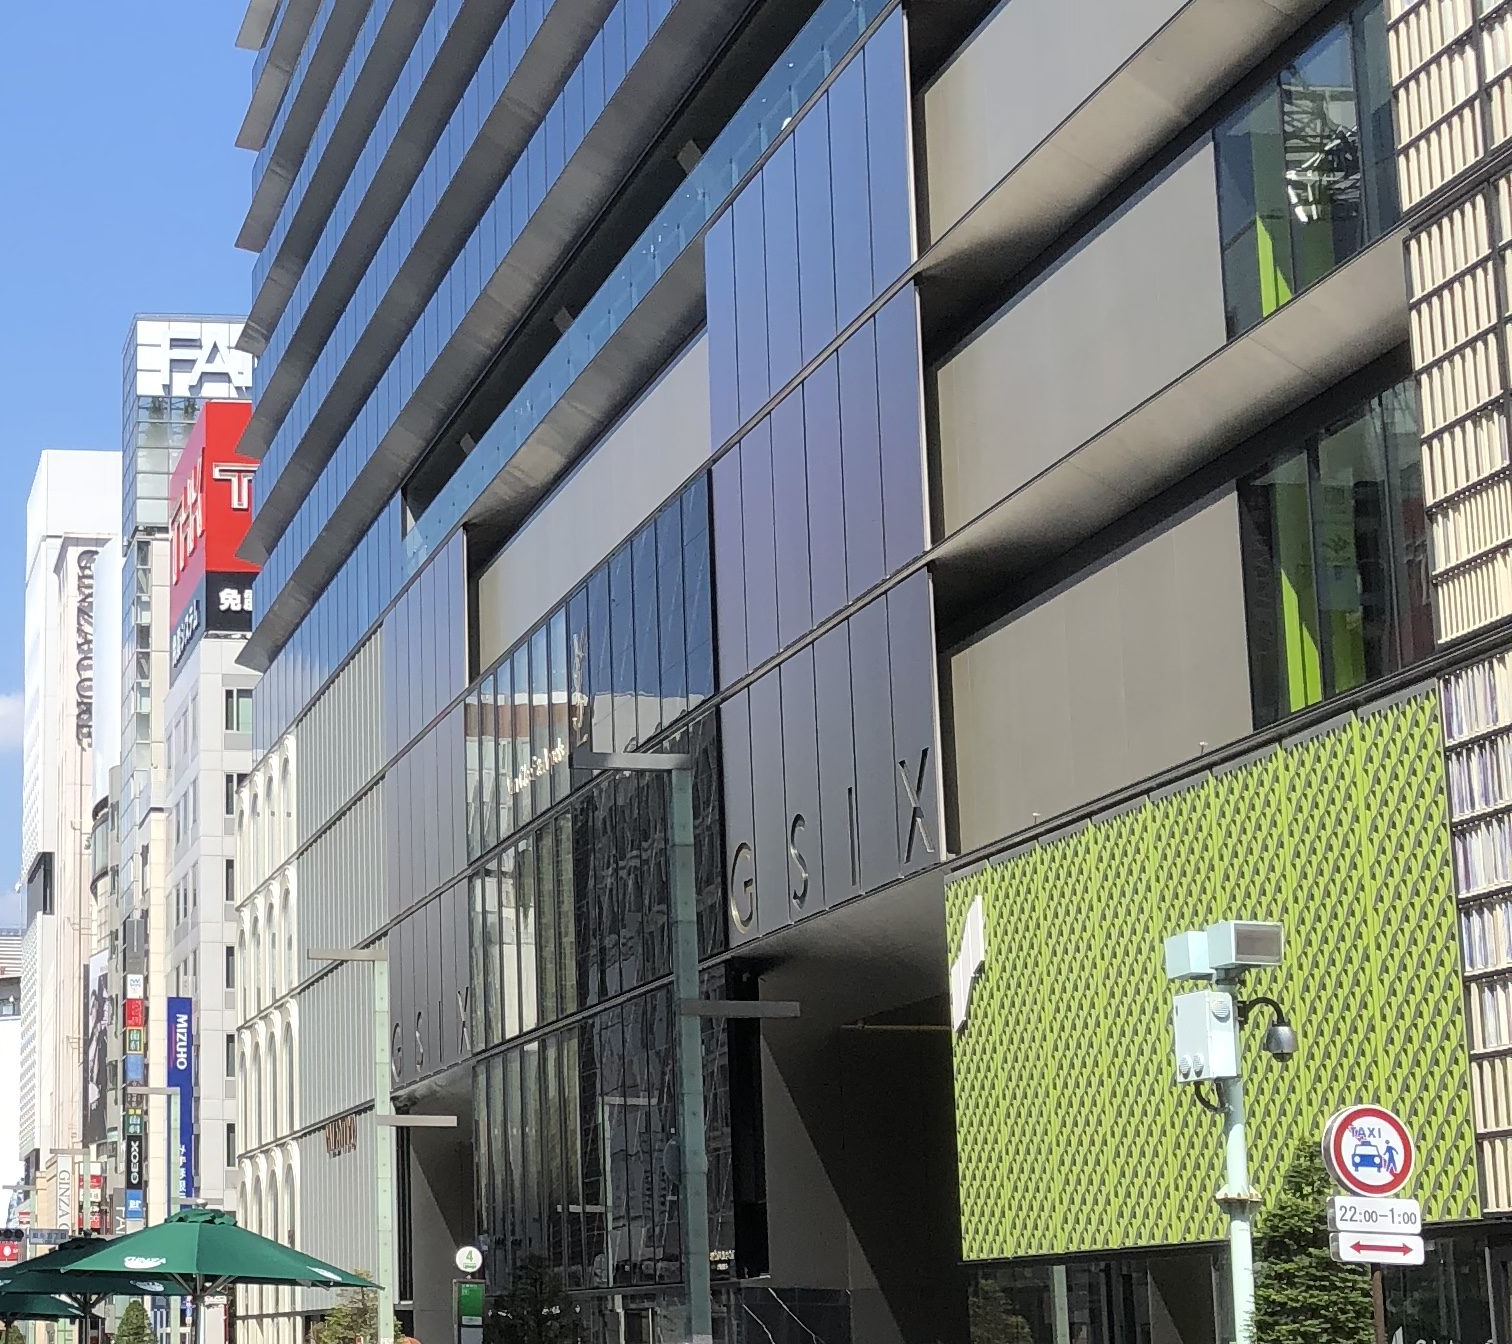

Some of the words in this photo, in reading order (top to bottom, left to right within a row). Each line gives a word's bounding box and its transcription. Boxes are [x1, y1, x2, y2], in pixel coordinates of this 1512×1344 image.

[161, 332, 252, 396] FA
[176, 1014, 188, 1070] MIZUHO
[1351, 1126, 1382, 1139] TAXI
[131, 1140, 139, 1184] GEOX
[58, 1169, 71, 1219] GINZA
[465, 1249, 474, 1262] 4
